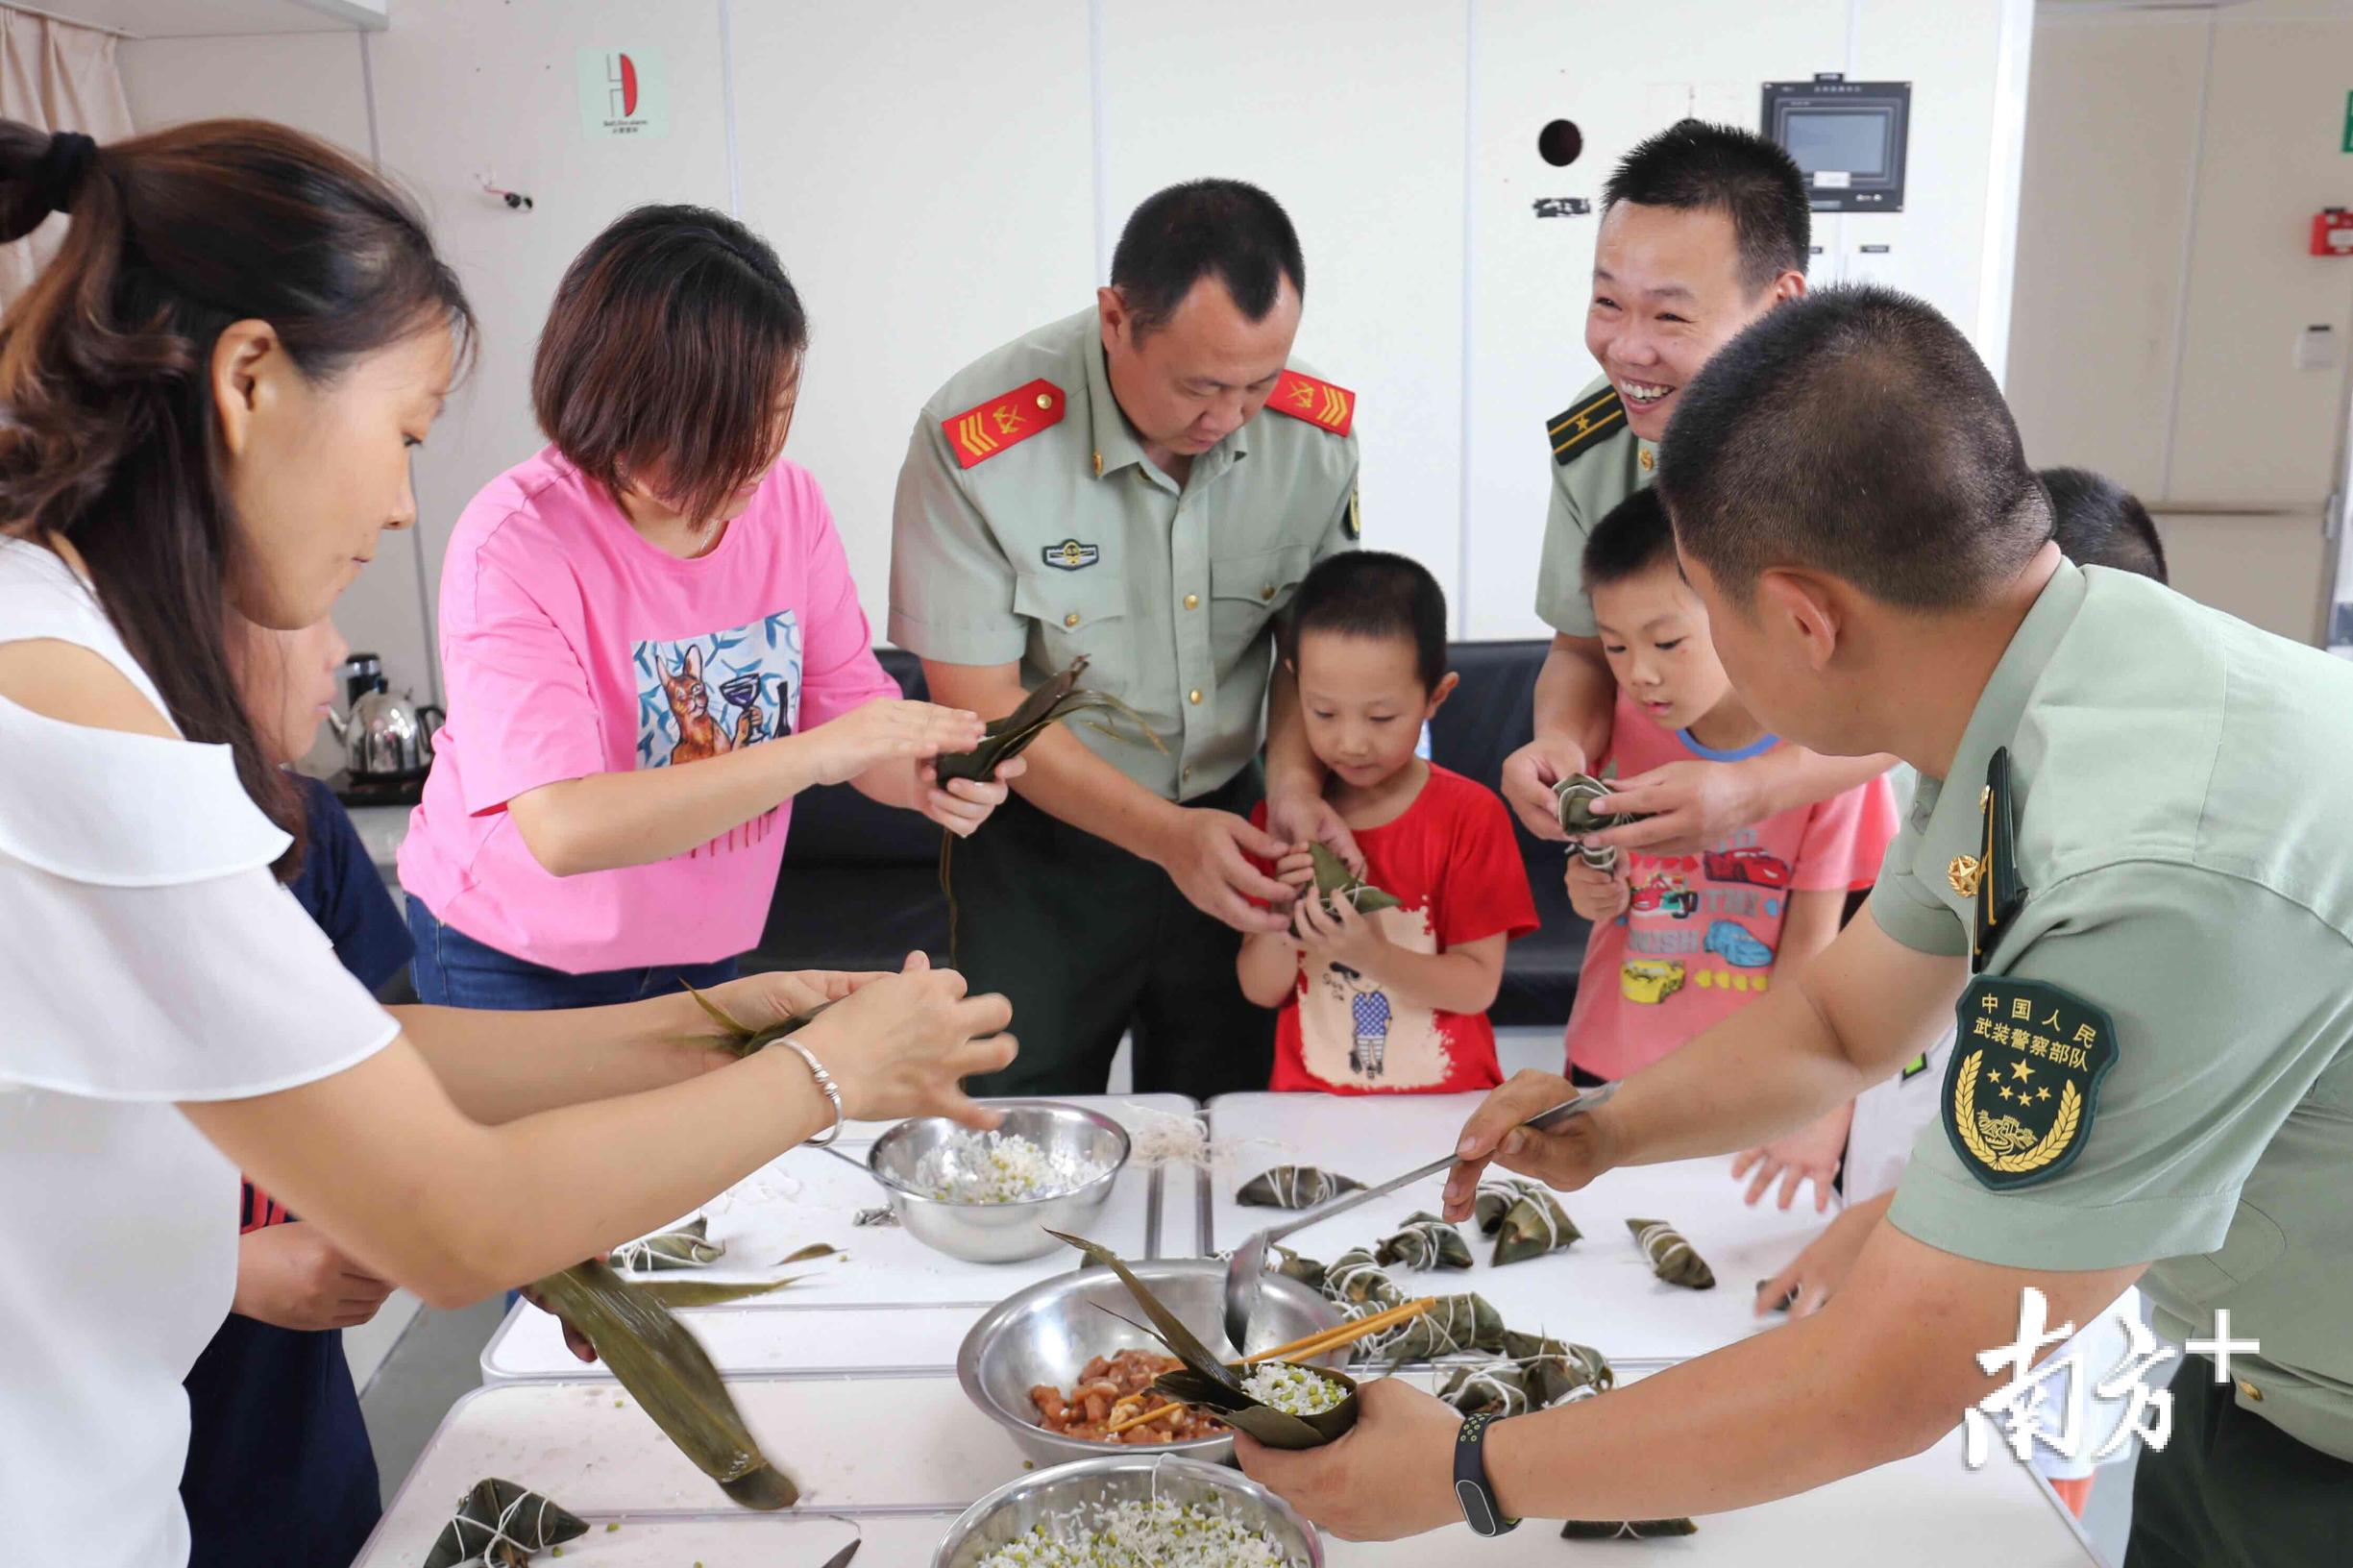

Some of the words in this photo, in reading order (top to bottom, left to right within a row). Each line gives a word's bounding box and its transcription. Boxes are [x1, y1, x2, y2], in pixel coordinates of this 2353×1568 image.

[1973, 1017, 2089, 1073] 武装警察部队
[1981, 992, 2097, 1049] 中国人民
